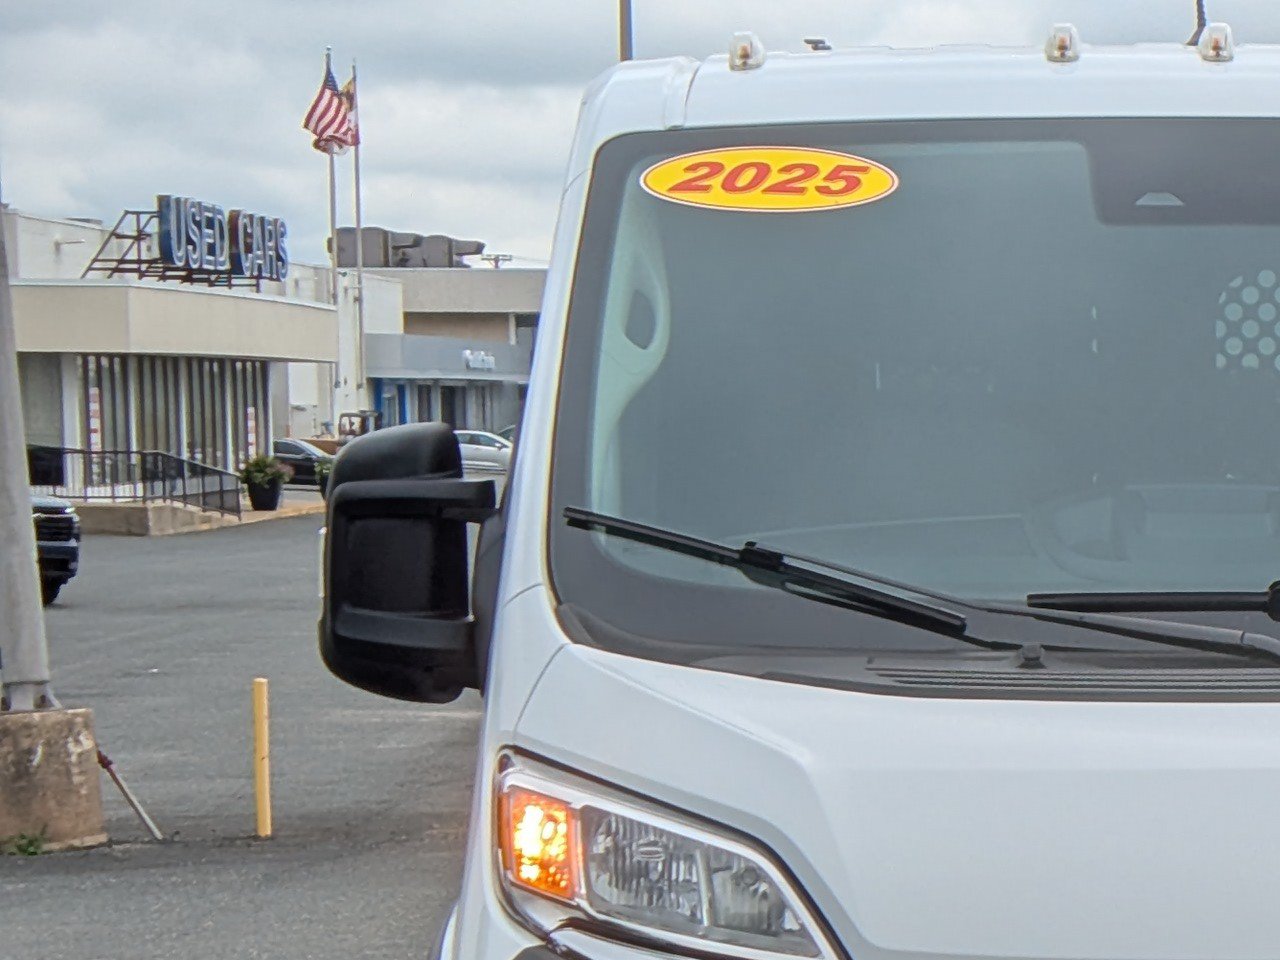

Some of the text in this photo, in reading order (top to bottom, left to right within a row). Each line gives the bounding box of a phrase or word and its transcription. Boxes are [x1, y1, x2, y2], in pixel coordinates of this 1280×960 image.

[667, 161, 872, 197] 2025
[169, 196, 288, 280] USED CARS
